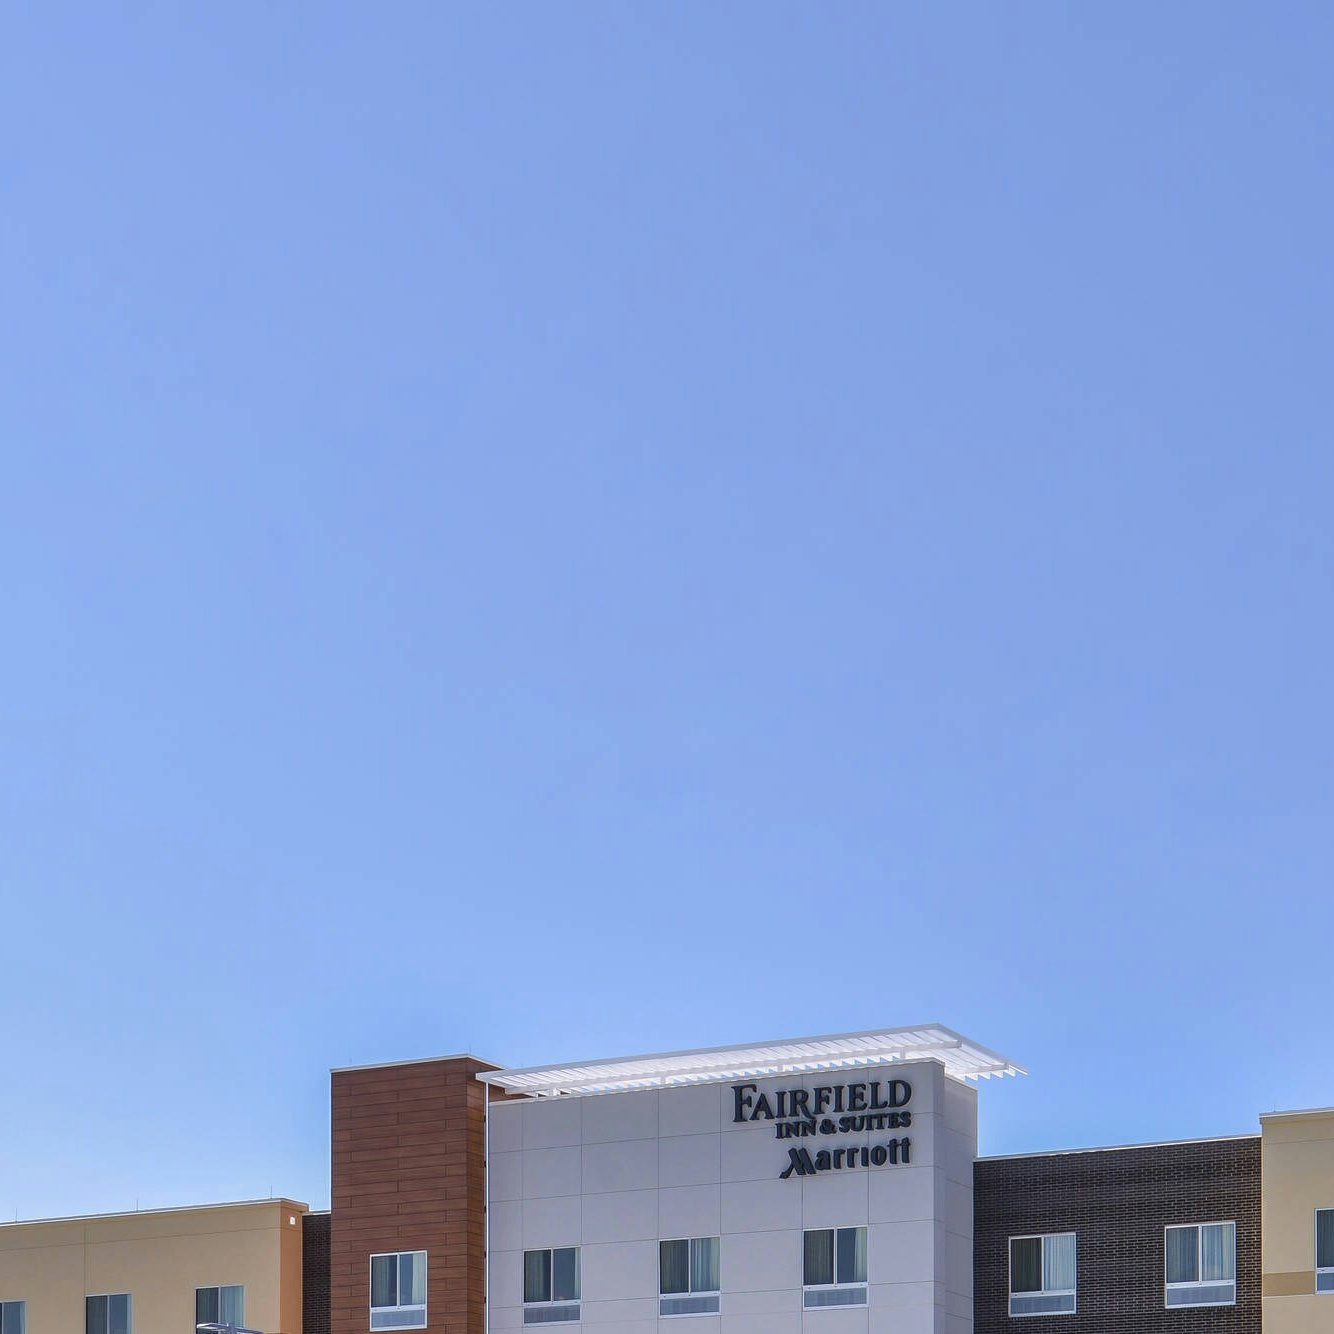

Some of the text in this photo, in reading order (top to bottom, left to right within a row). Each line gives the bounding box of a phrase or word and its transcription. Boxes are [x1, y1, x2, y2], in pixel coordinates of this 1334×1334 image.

[731, 1080, 912, 1122] FAIRFIELD
[775, 1111, 912, 1139] INN & SUITES
[779, 1137, 911, 1179] Marriott
